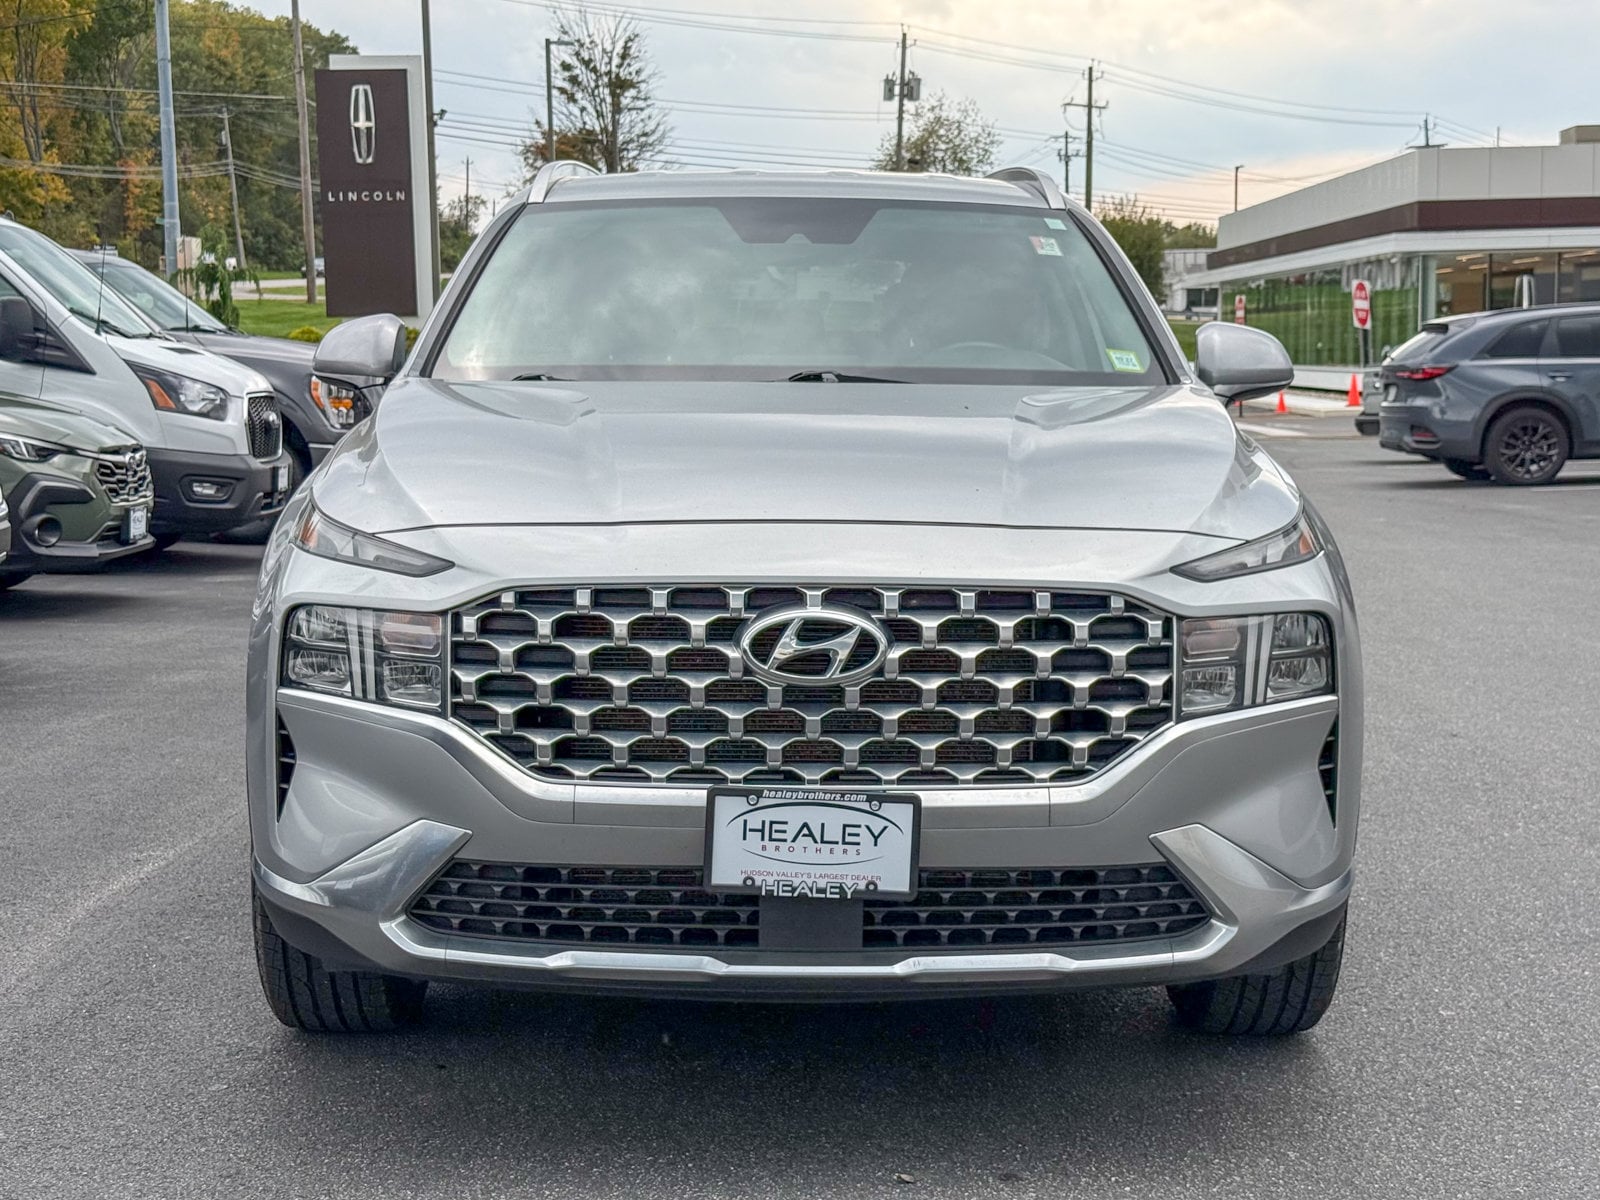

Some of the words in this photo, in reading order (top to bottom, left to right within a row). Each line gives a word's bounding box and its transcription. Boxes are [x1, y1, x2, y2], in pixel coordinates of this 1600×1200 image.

[328, 190, 406, 202] LINCOLN
[762, 789, 868, 802] healeybrothers.com
[742, 819, 889, 847] HEALEY
[761, 844, 861, 856] BROTHERS
[740, 869, 774, 878] HUDSON
[776, 870, 812, 879] VALLEY'S
[813, 872, 849, 881] LARGEST
[850, 873, 882, 882] DEALER
[760, 879, 859, 899] HEALEY
